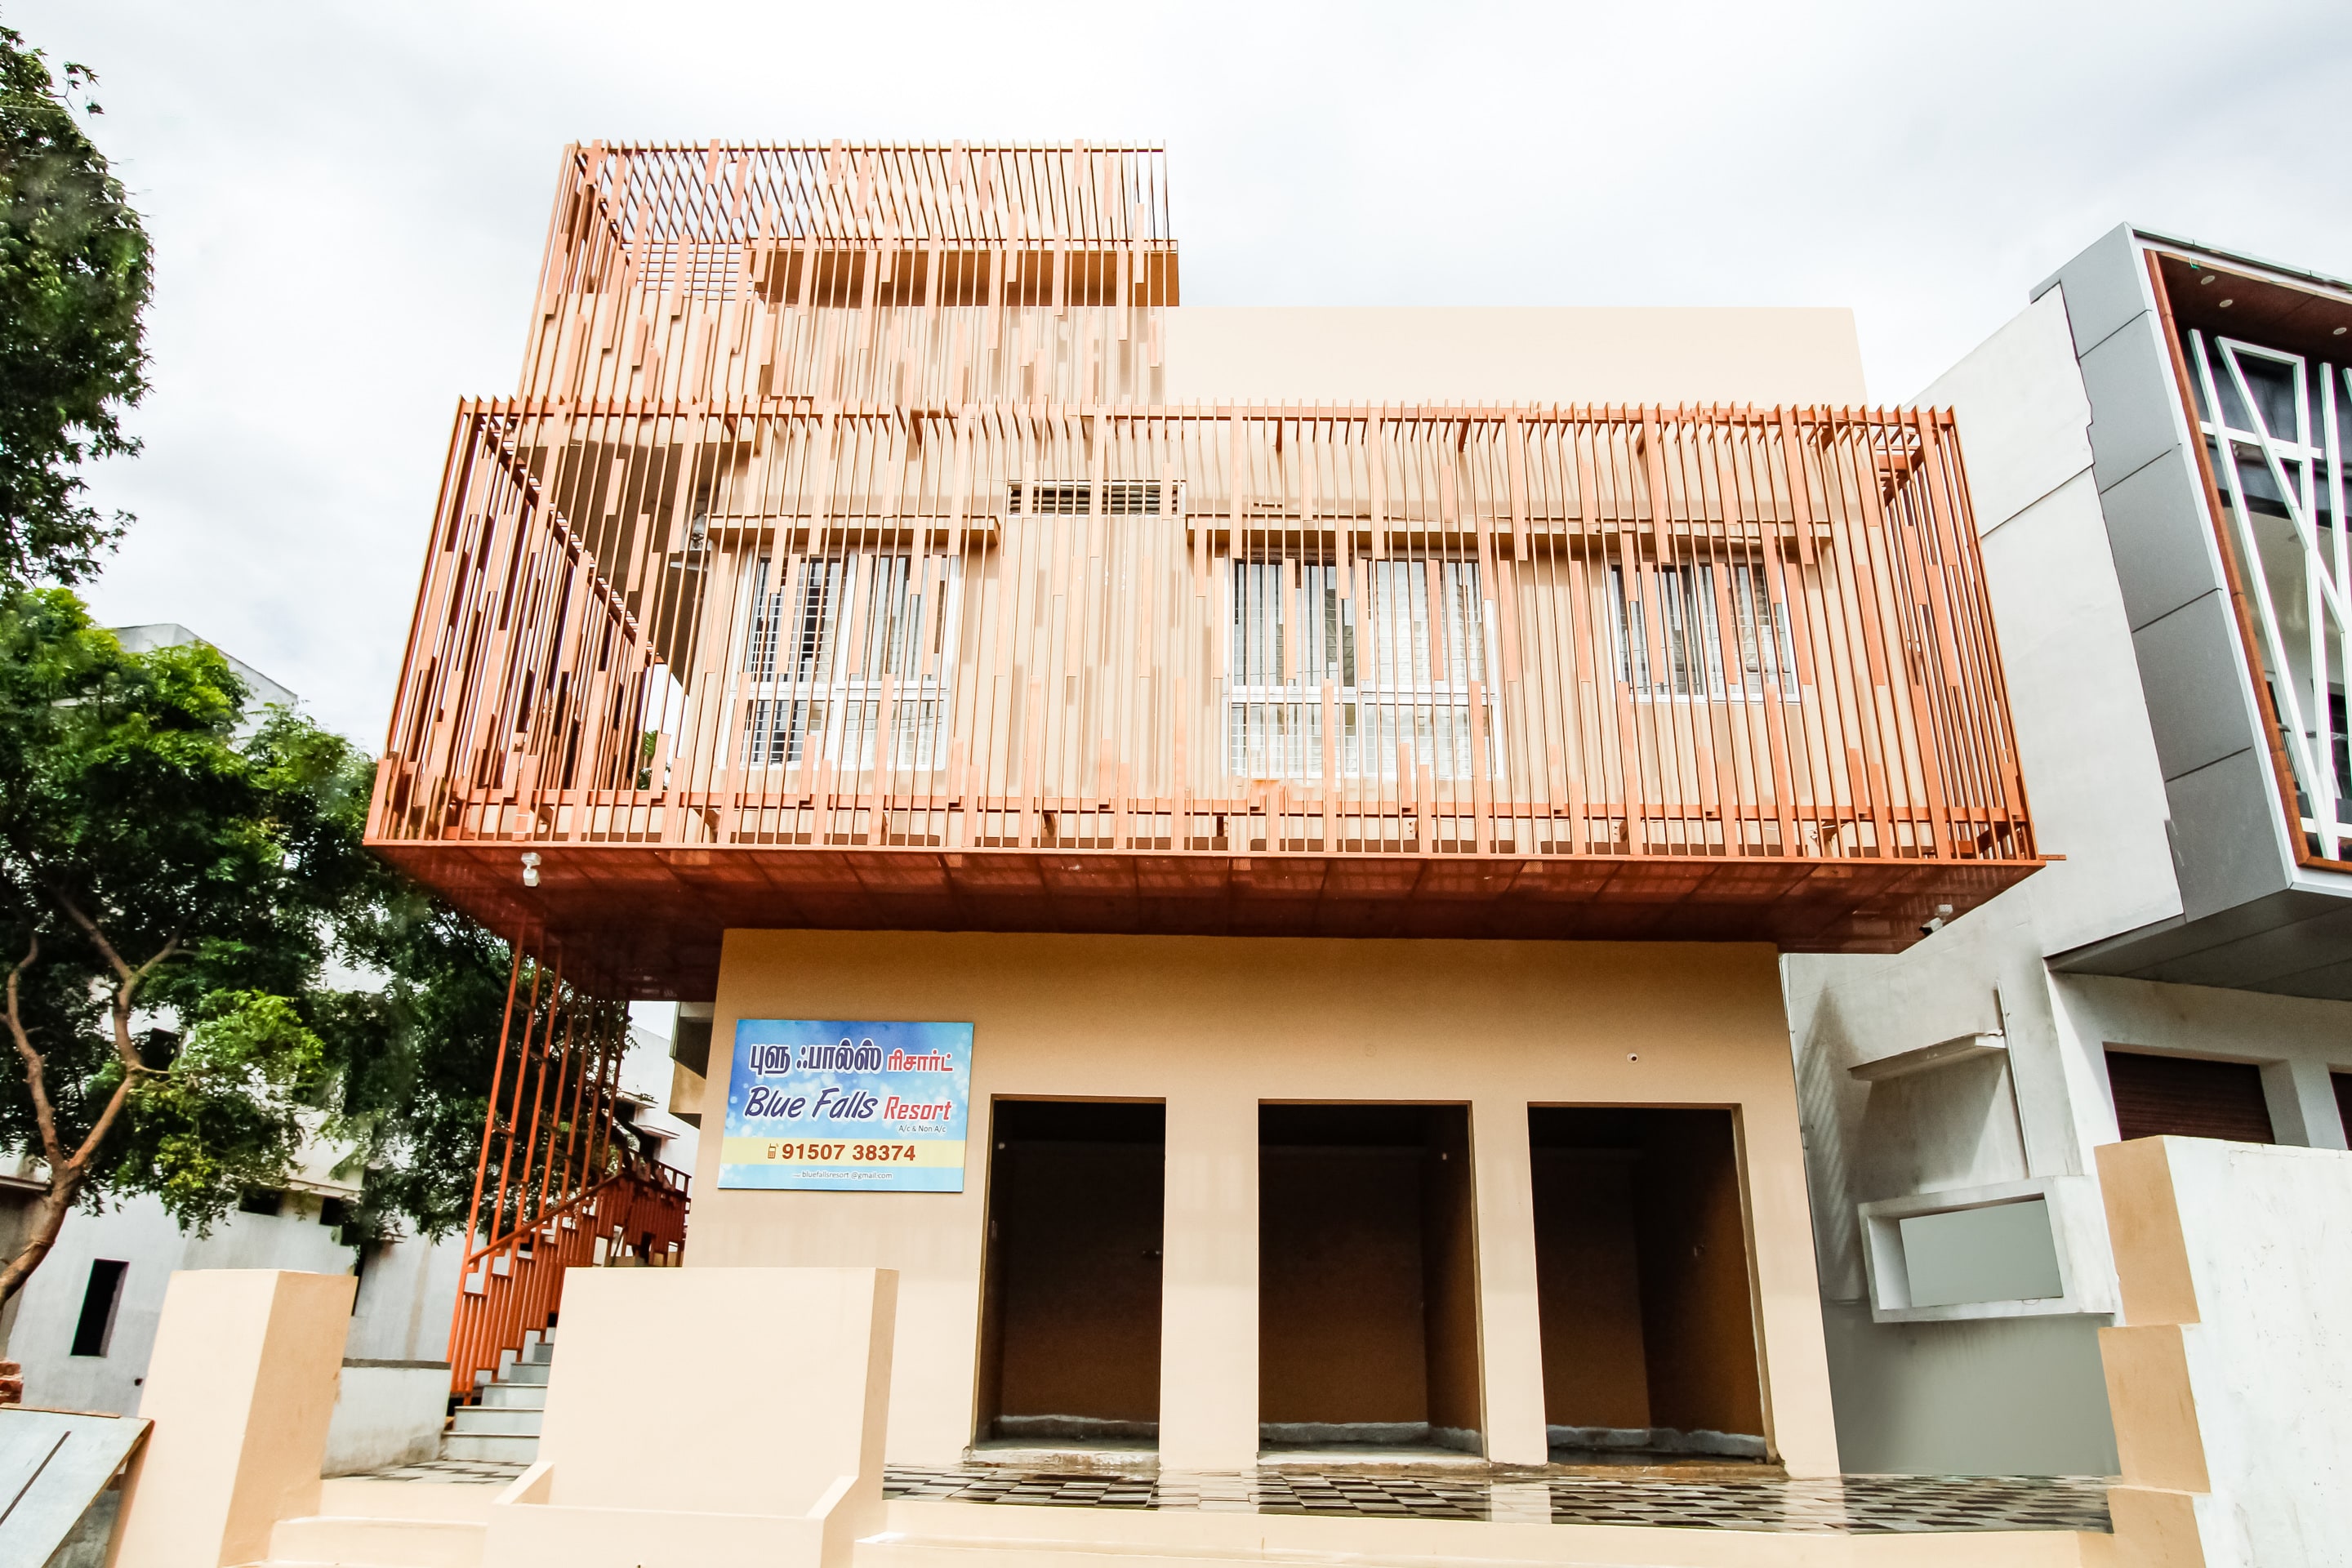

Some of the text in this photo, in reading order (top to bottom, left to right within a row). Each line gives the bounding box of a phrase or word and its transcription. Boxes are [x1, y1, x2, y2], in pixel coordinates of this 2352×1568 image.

[888, 1049, 954, 1071] ரிசார்ட்
[744, 1086, 952, 1120] Blue Falls Resort
[898, 1125, 910, 1134] A/c
[933, 1125, 947, 1134] A/c
[782, 1143, 915, 1161] 91507 38374
[801, 1170, 849, 1178] bluefallsresort
